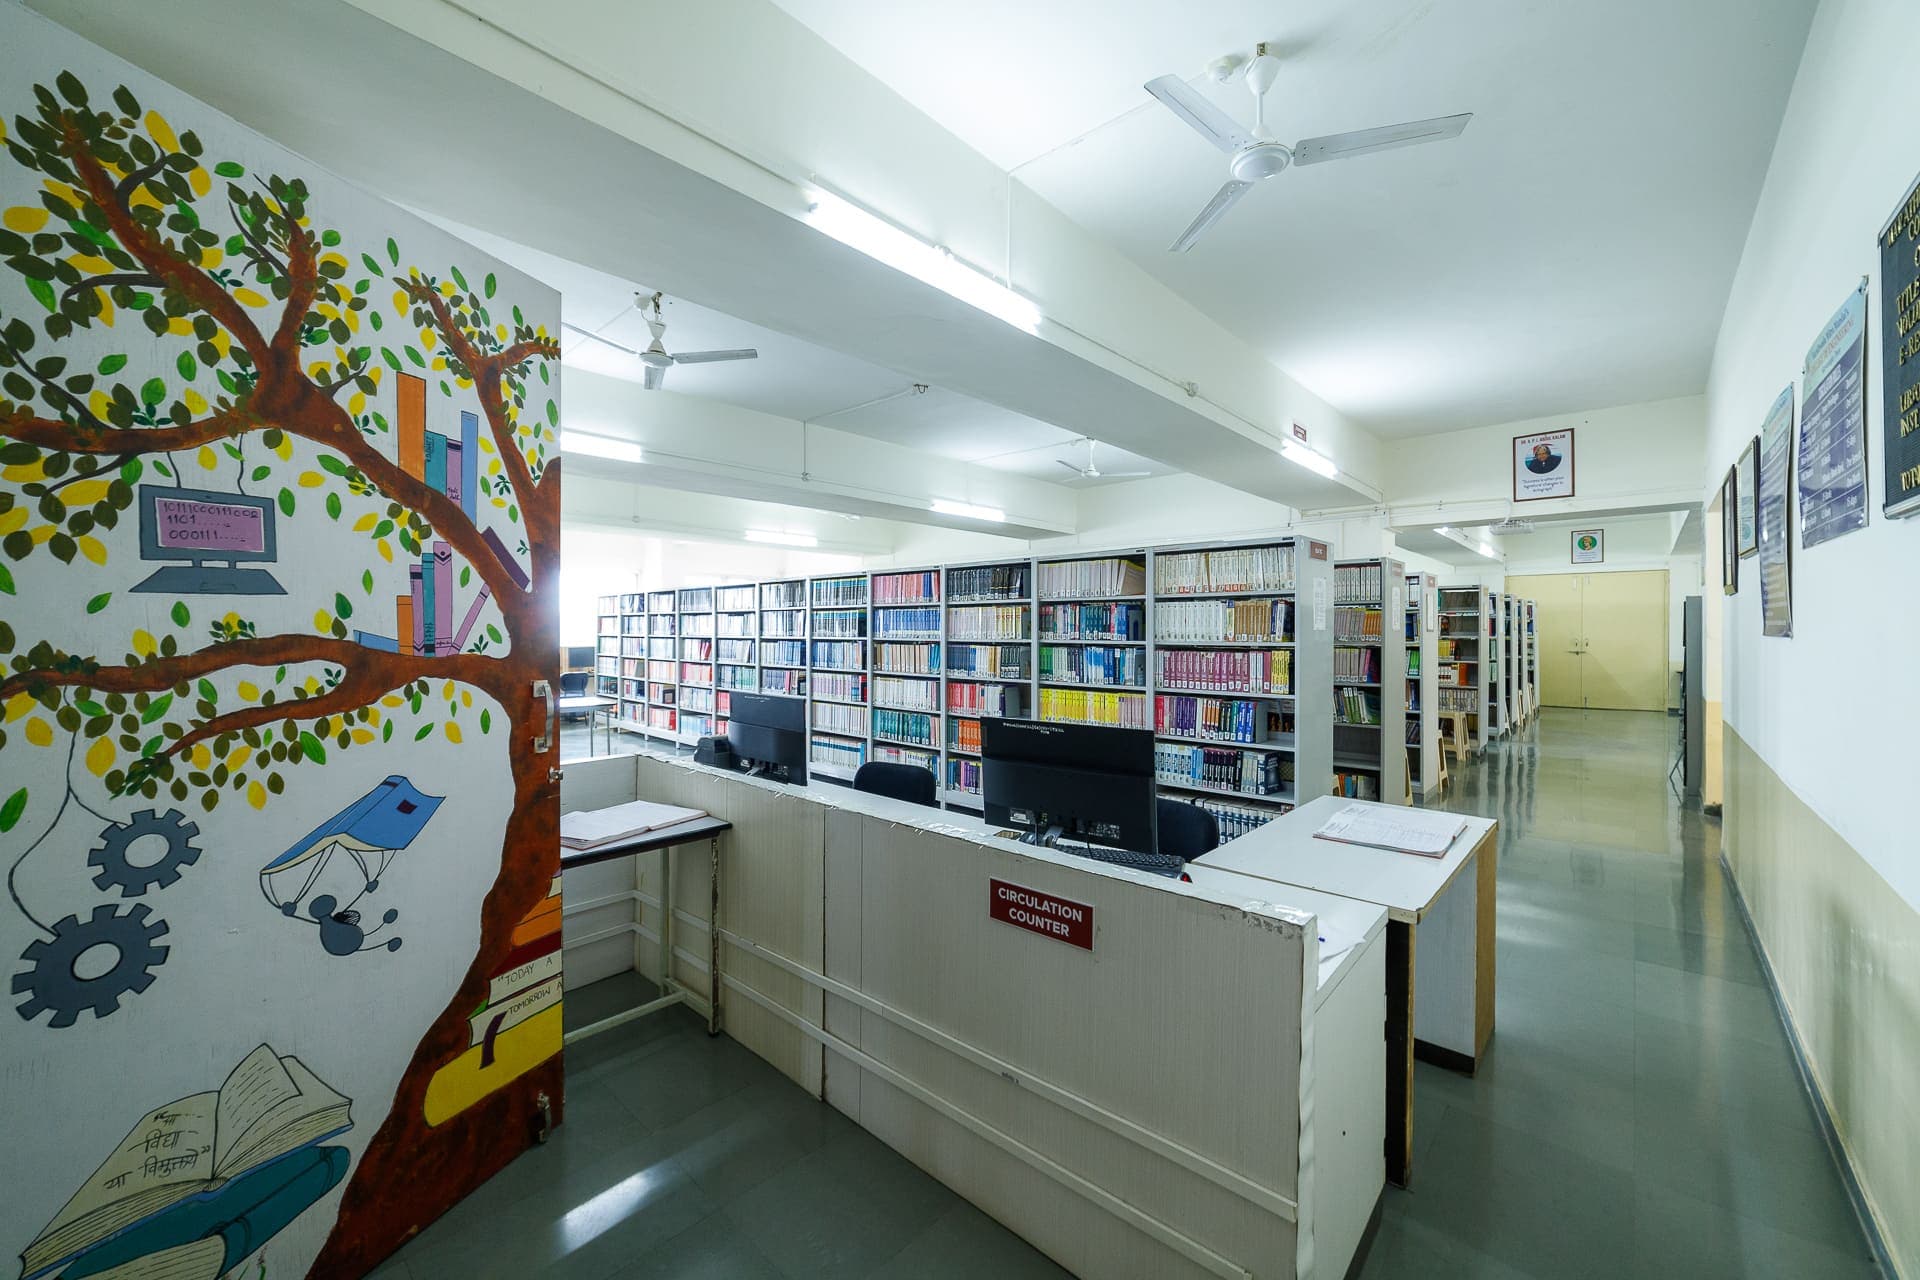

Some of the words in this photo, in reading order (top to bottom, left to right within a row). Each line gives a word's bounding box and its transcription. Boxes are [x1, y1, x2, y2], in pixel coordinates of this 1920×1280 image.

[998, 887, 1082, 923] CIRCULATION
[1009, 907, 1070, 937] COUNTER
[509, 986, 551, 1015] TOMORROW
